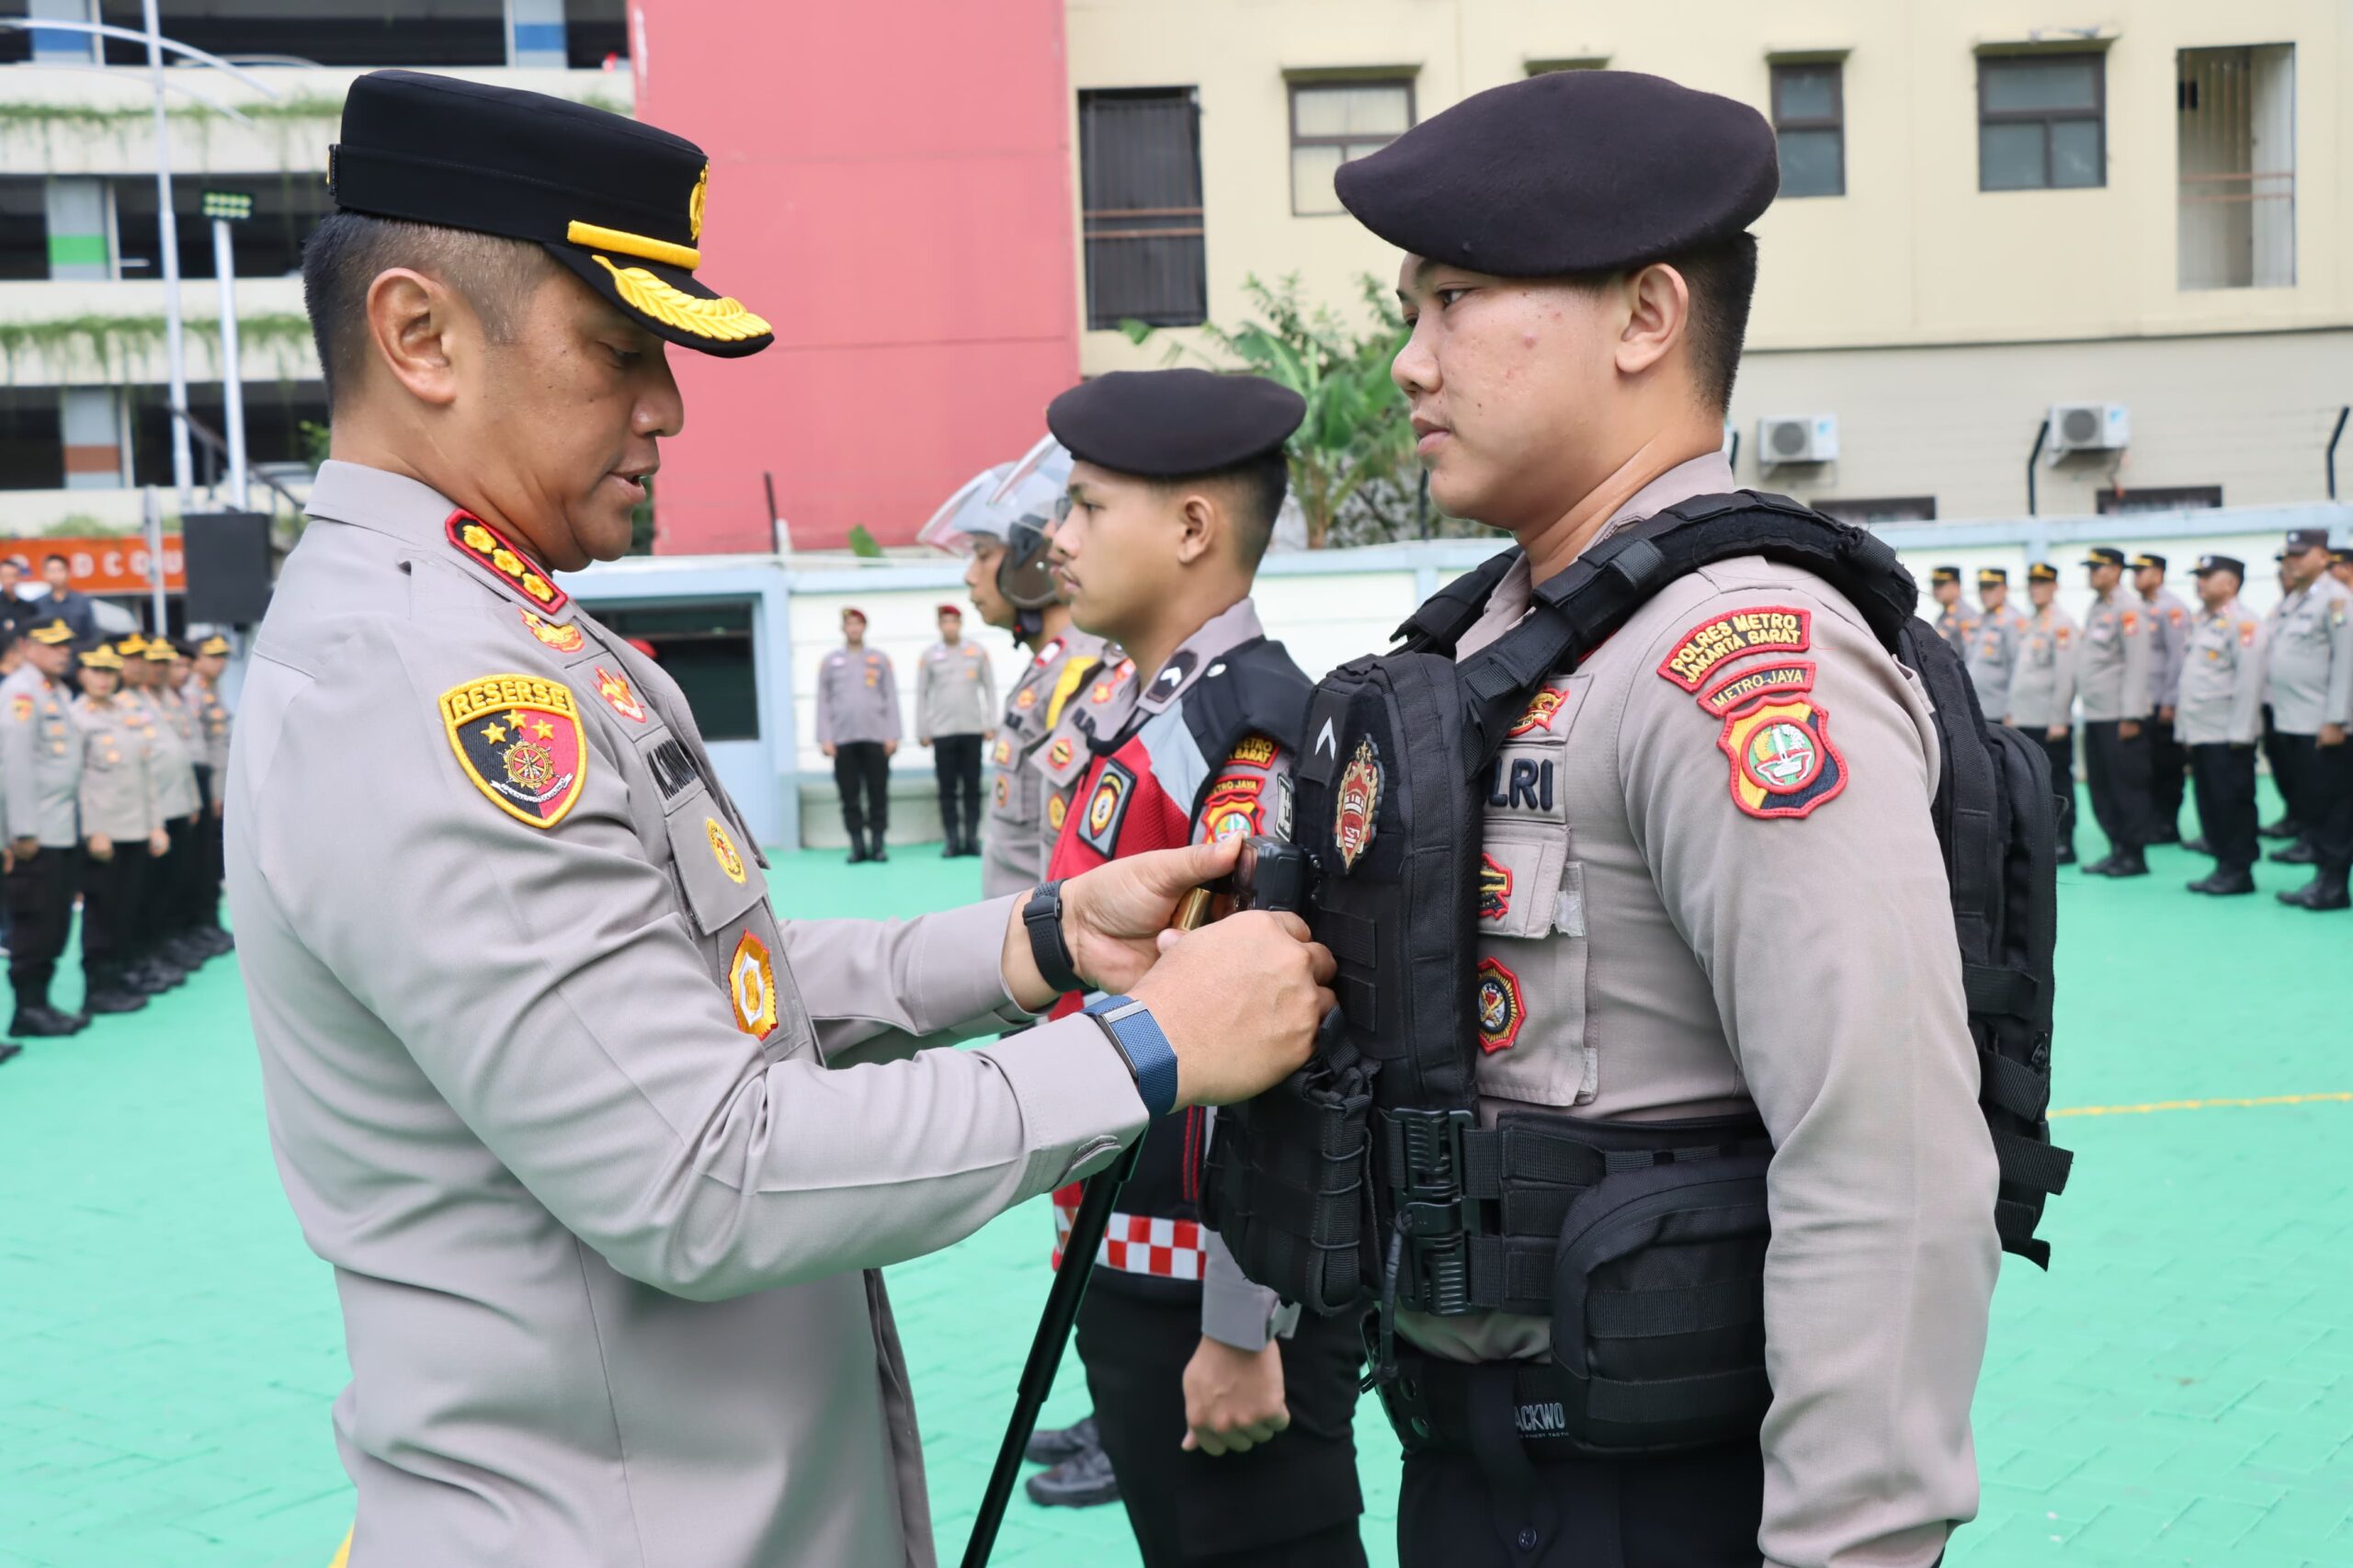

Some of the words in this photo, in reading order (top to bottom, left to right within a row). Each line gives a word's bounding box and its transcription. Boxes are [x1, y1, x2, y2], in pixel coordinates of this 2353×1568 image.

[1670, 621, 1733, 672] POLRES
[1732, 613, 1797, 632] METRO
[1684, 633, 1746, 683] JAKARTA
[1747, 629, 1801, 644] BARAT
[451, 681, 568, 716] RESERSE
[1711, 675, 1765, 707] METRO
[1768, 669, 1803, 684] JAYA
[1234, 749, 1270, 763] BARAT
[1235, 779, 1256, 790] JAYA
